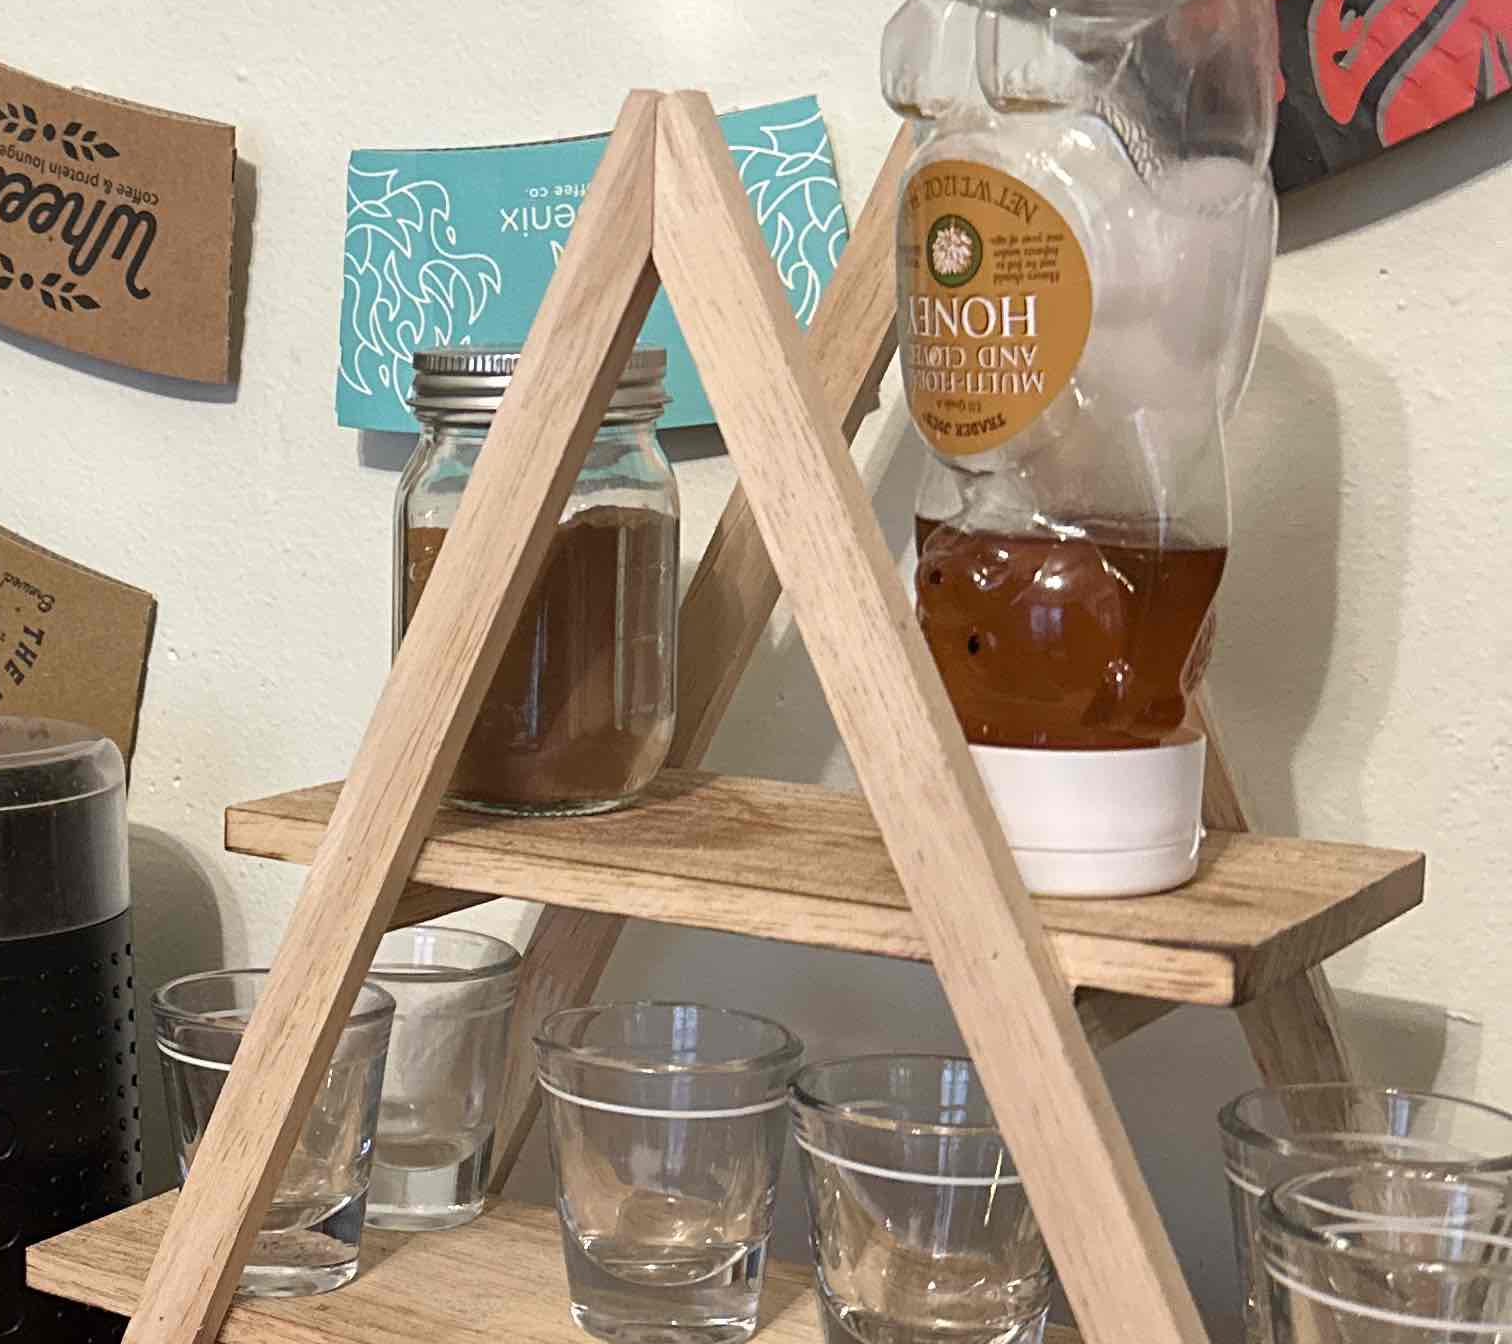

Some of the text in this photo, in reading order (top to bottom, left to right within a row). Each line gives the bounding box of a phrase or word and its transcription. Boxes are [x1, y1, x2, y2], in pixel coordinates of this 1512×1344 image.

[48, 164, 101, 188] protein
[103, 178, 114, 194] &
[115, 184, 160, 206] coffee
[553, 182, 589, 198] ffee
[995, 187, 1040, 226] NET
[499, 203, 576, 238] enix
[907, 294, 1039, 338] HONEY
[977, 344, 1039, 370] AND
[955, 411, 1008, 438] TRADER
[4, 625, 46, 687] THE
